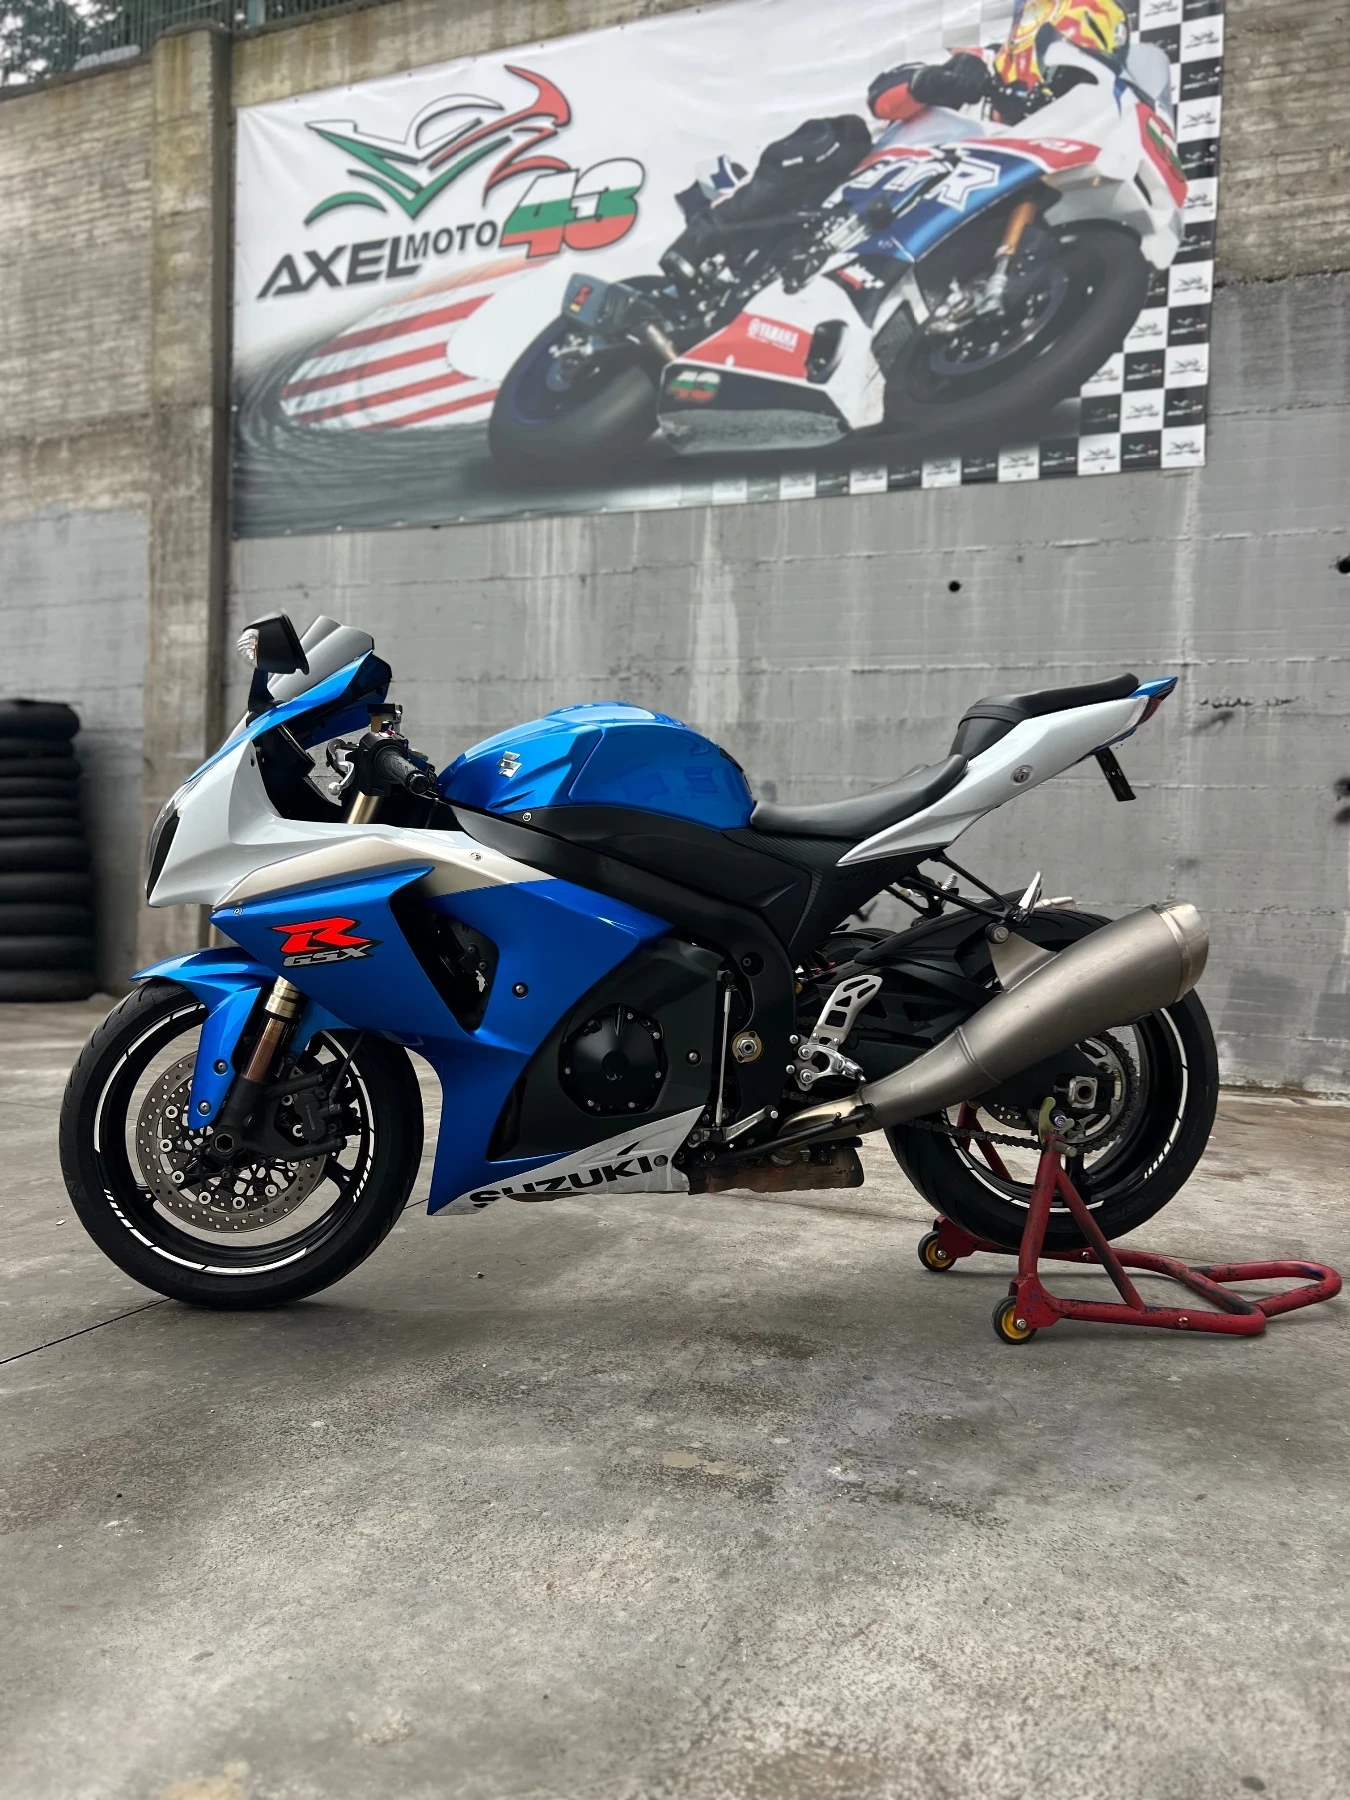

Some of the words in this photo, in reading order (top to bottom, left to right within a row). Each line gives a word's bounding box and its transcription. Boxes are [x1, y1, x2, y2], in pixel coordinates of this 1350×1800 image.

[269, 916, 373, 954] R
[282, 944, 374, 967] GSX
[469, 1155, 654, 1209] SUZUKI
